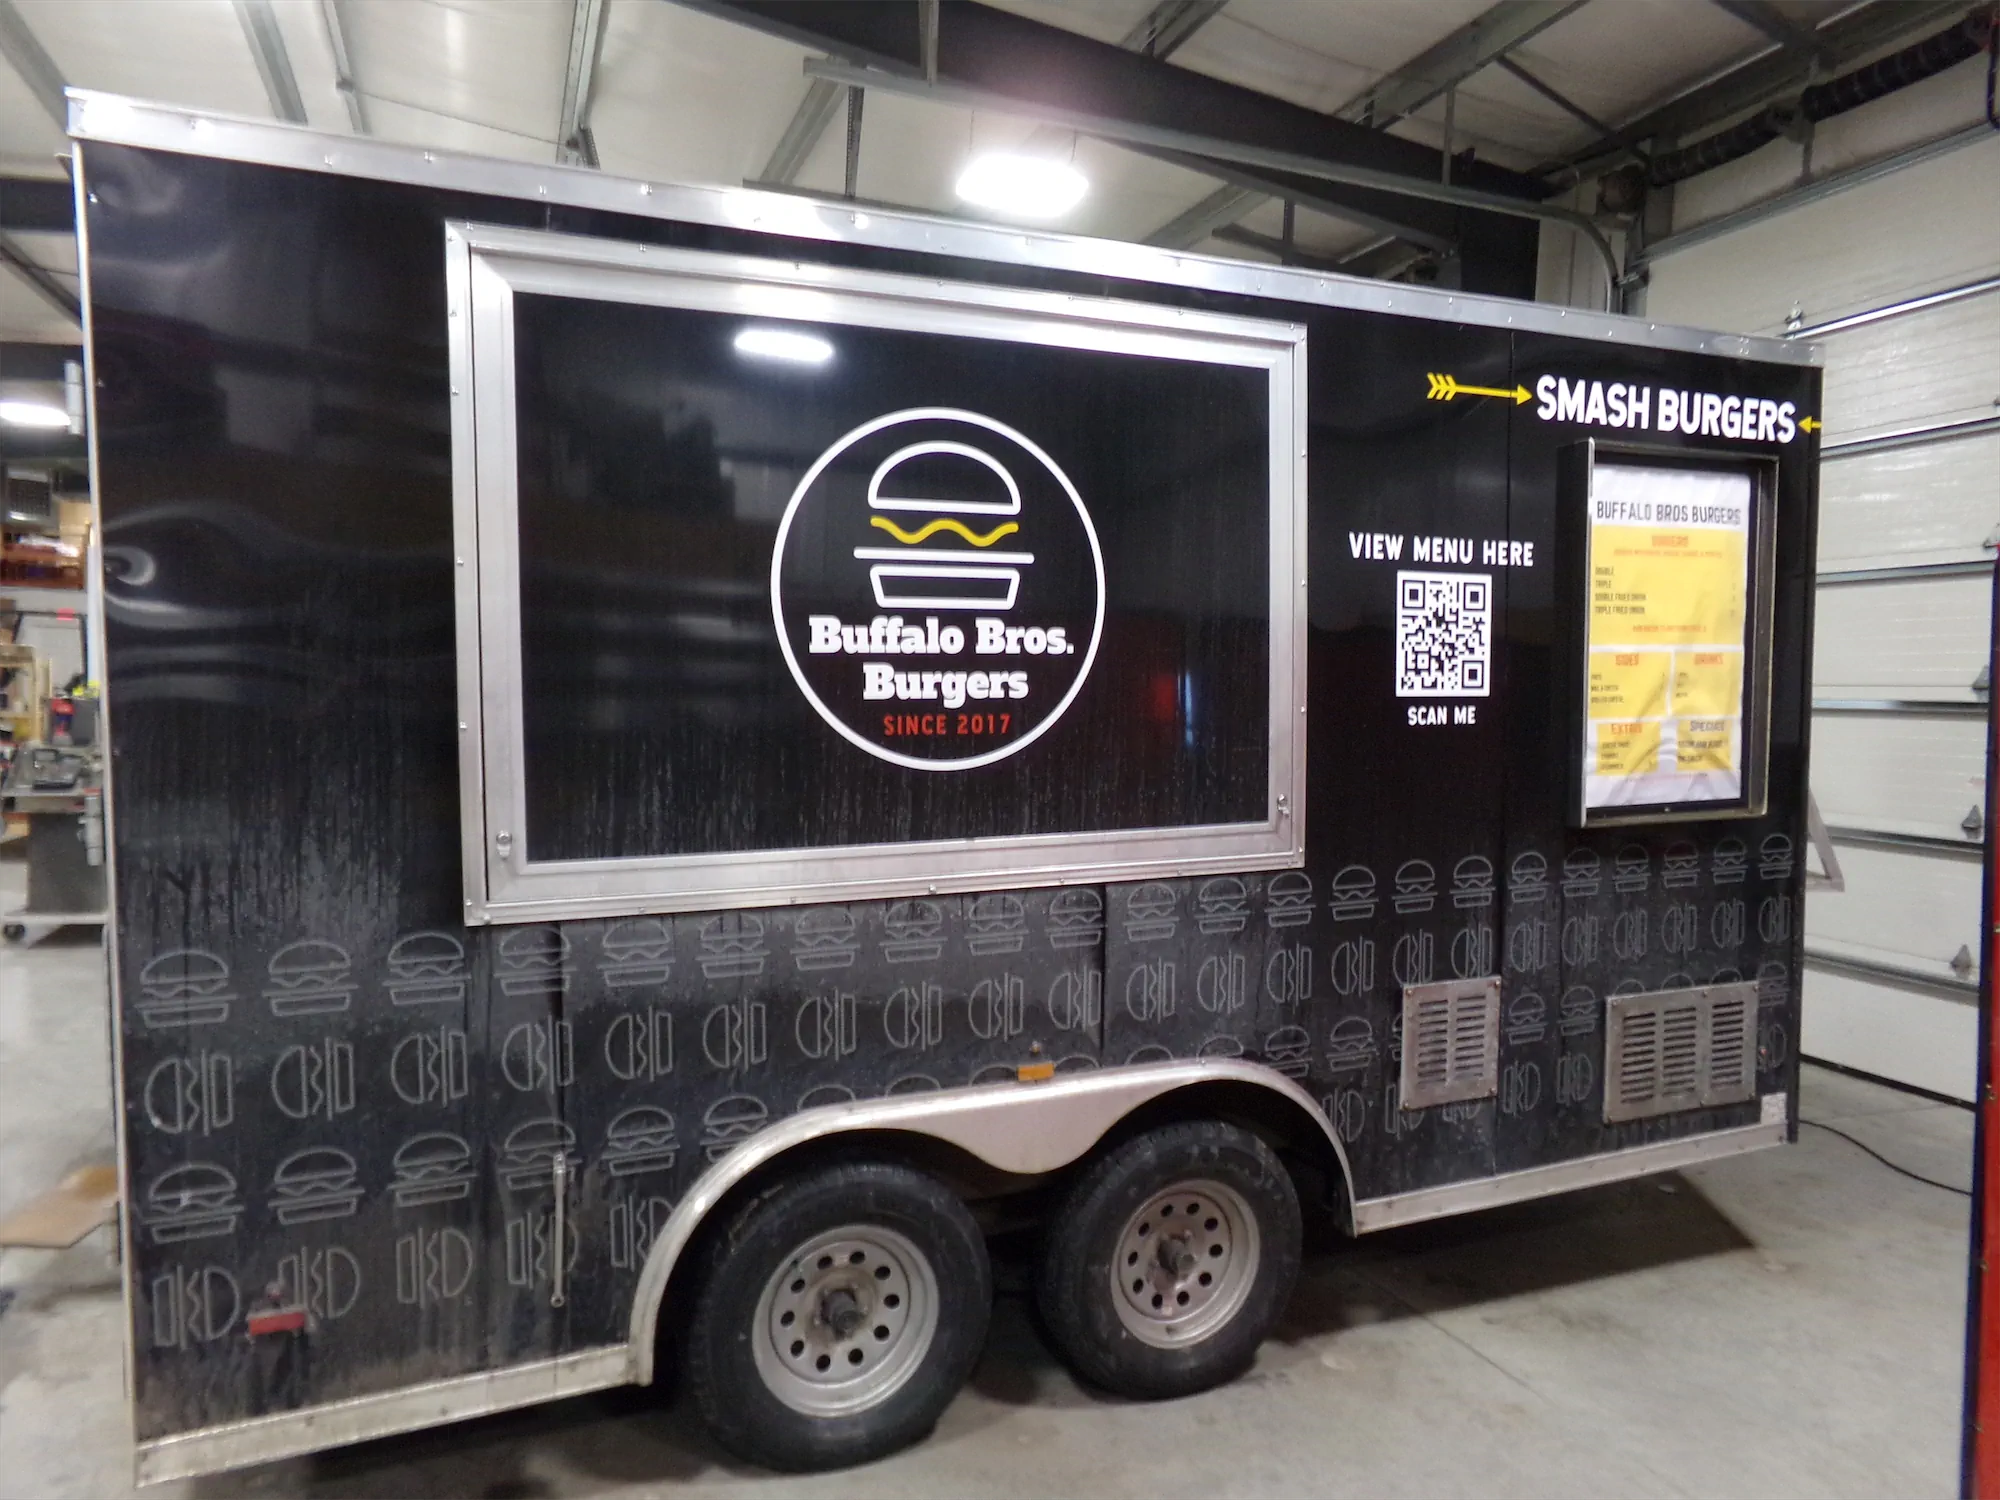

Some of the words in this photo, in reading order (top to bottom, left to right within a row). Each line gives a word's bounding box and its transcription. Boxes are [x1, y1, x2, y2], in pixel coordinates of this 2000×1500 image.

[1536, 373, 1650, 430] SMASH
[1657, 387, 1797, 444] BURGERS
[1596, 500, 1652, 521] BUFFALO
[1656, 503, 1688, 523] BROS
[1692, 505, 1741, 526] BURGERS
[1348, 531, 1405, 562] VIEW
[1413, 535, 1473, 565] MENU
[1482, 539, 1534, 567] HERE
[808, 614, 966, 655] Buffalo
[975, 616, 1075, 656] Bros.
[862, 661, 1030, 710] Burgers
[883, 714, 947, 737] SINCE
[957, 713, 1012, 737] 2017
[1407, 705, 1448, 726] SCAN
[1453, 705, 1477, 725] ME
